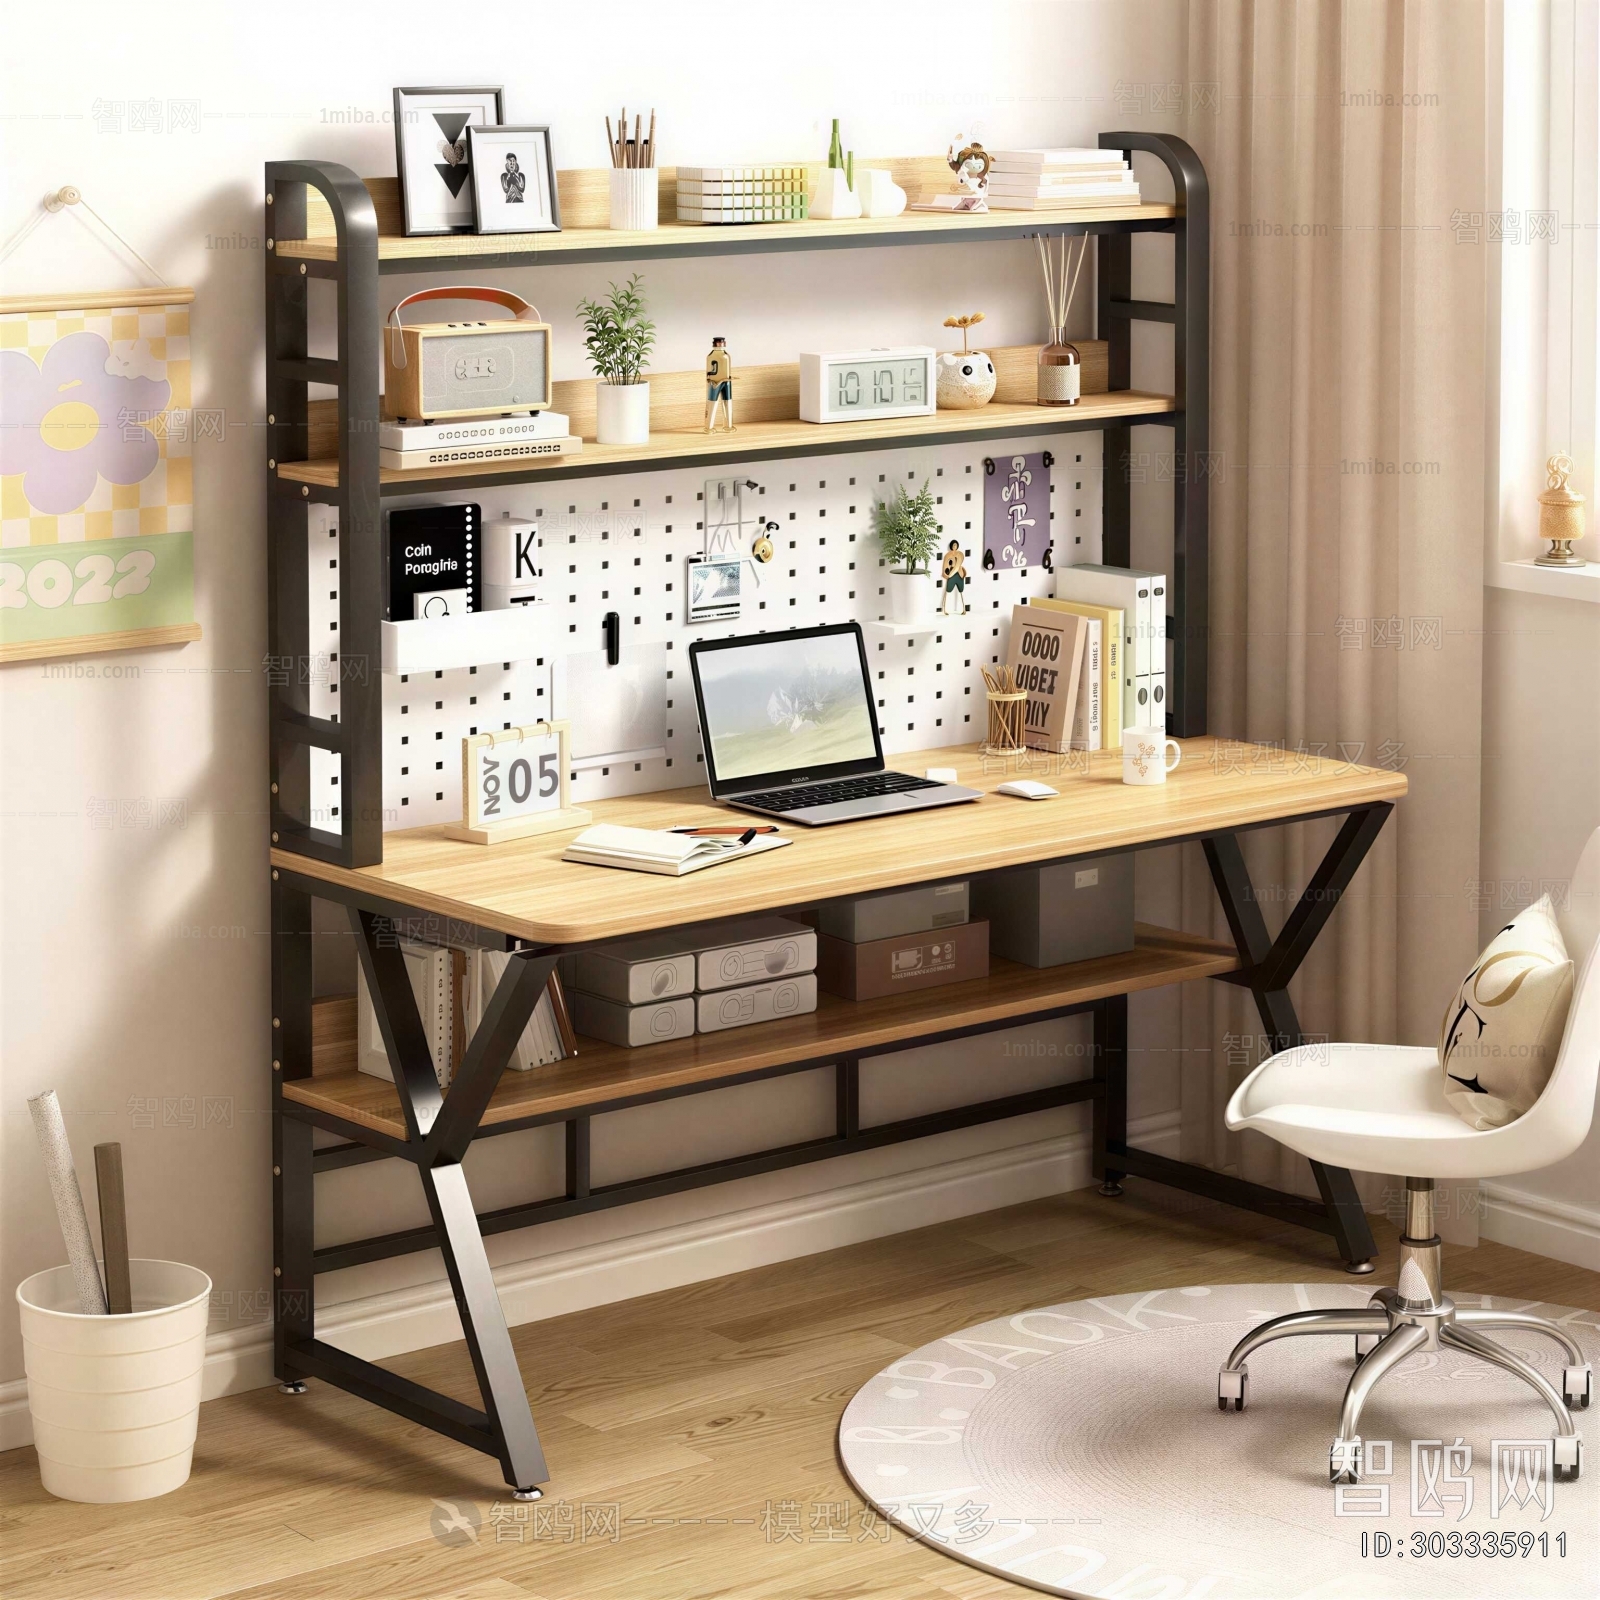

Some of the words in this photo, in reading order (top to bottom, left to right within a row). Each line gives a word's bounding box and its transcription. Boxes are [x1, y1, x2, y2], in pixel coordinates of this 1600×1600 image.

[515, 531, 537, 578] K
[483, 756, 500, 816] NOV
[508, 753, 559, 804] 05
